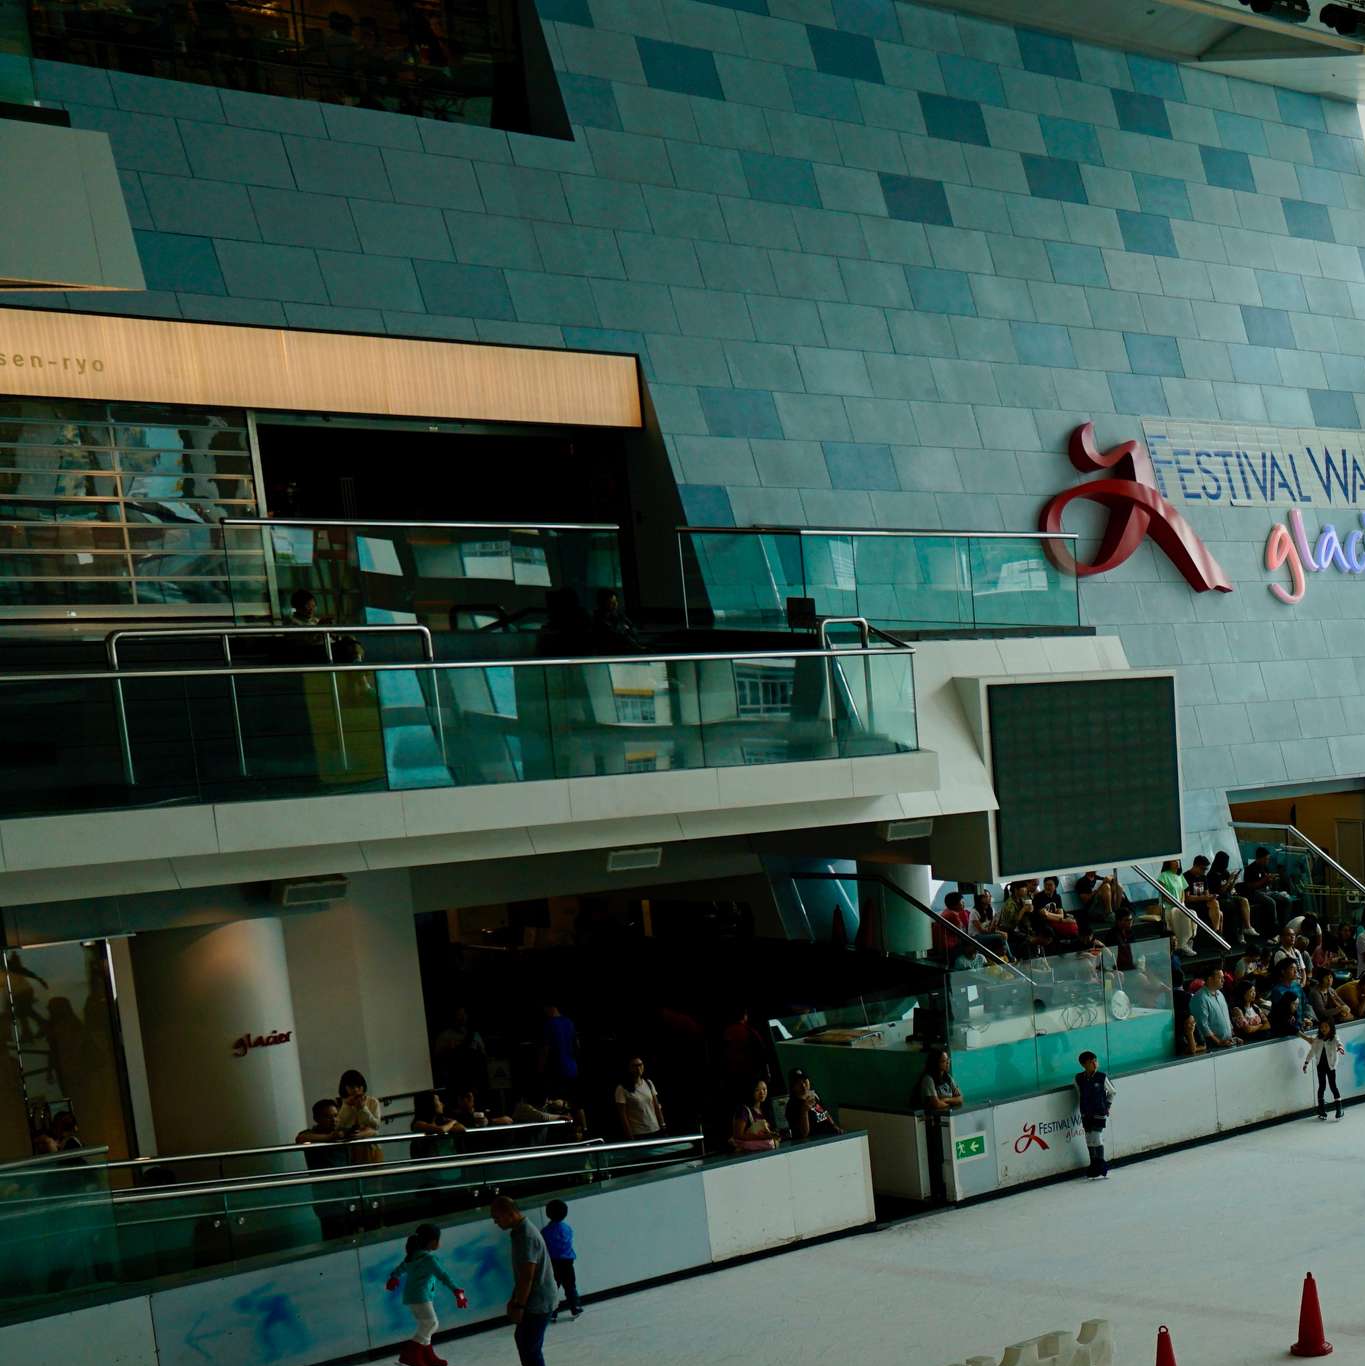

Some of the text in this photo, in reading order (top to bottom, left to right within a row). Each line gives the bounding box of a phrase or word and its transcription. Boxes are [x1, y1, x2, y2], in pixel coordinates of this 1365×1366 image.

[1149, 434, 1312, 503] FESTIVAL
[232, 1029, 292, 1057] glacier
[1039, 1118, 1071, 1135] FESTIVAL
